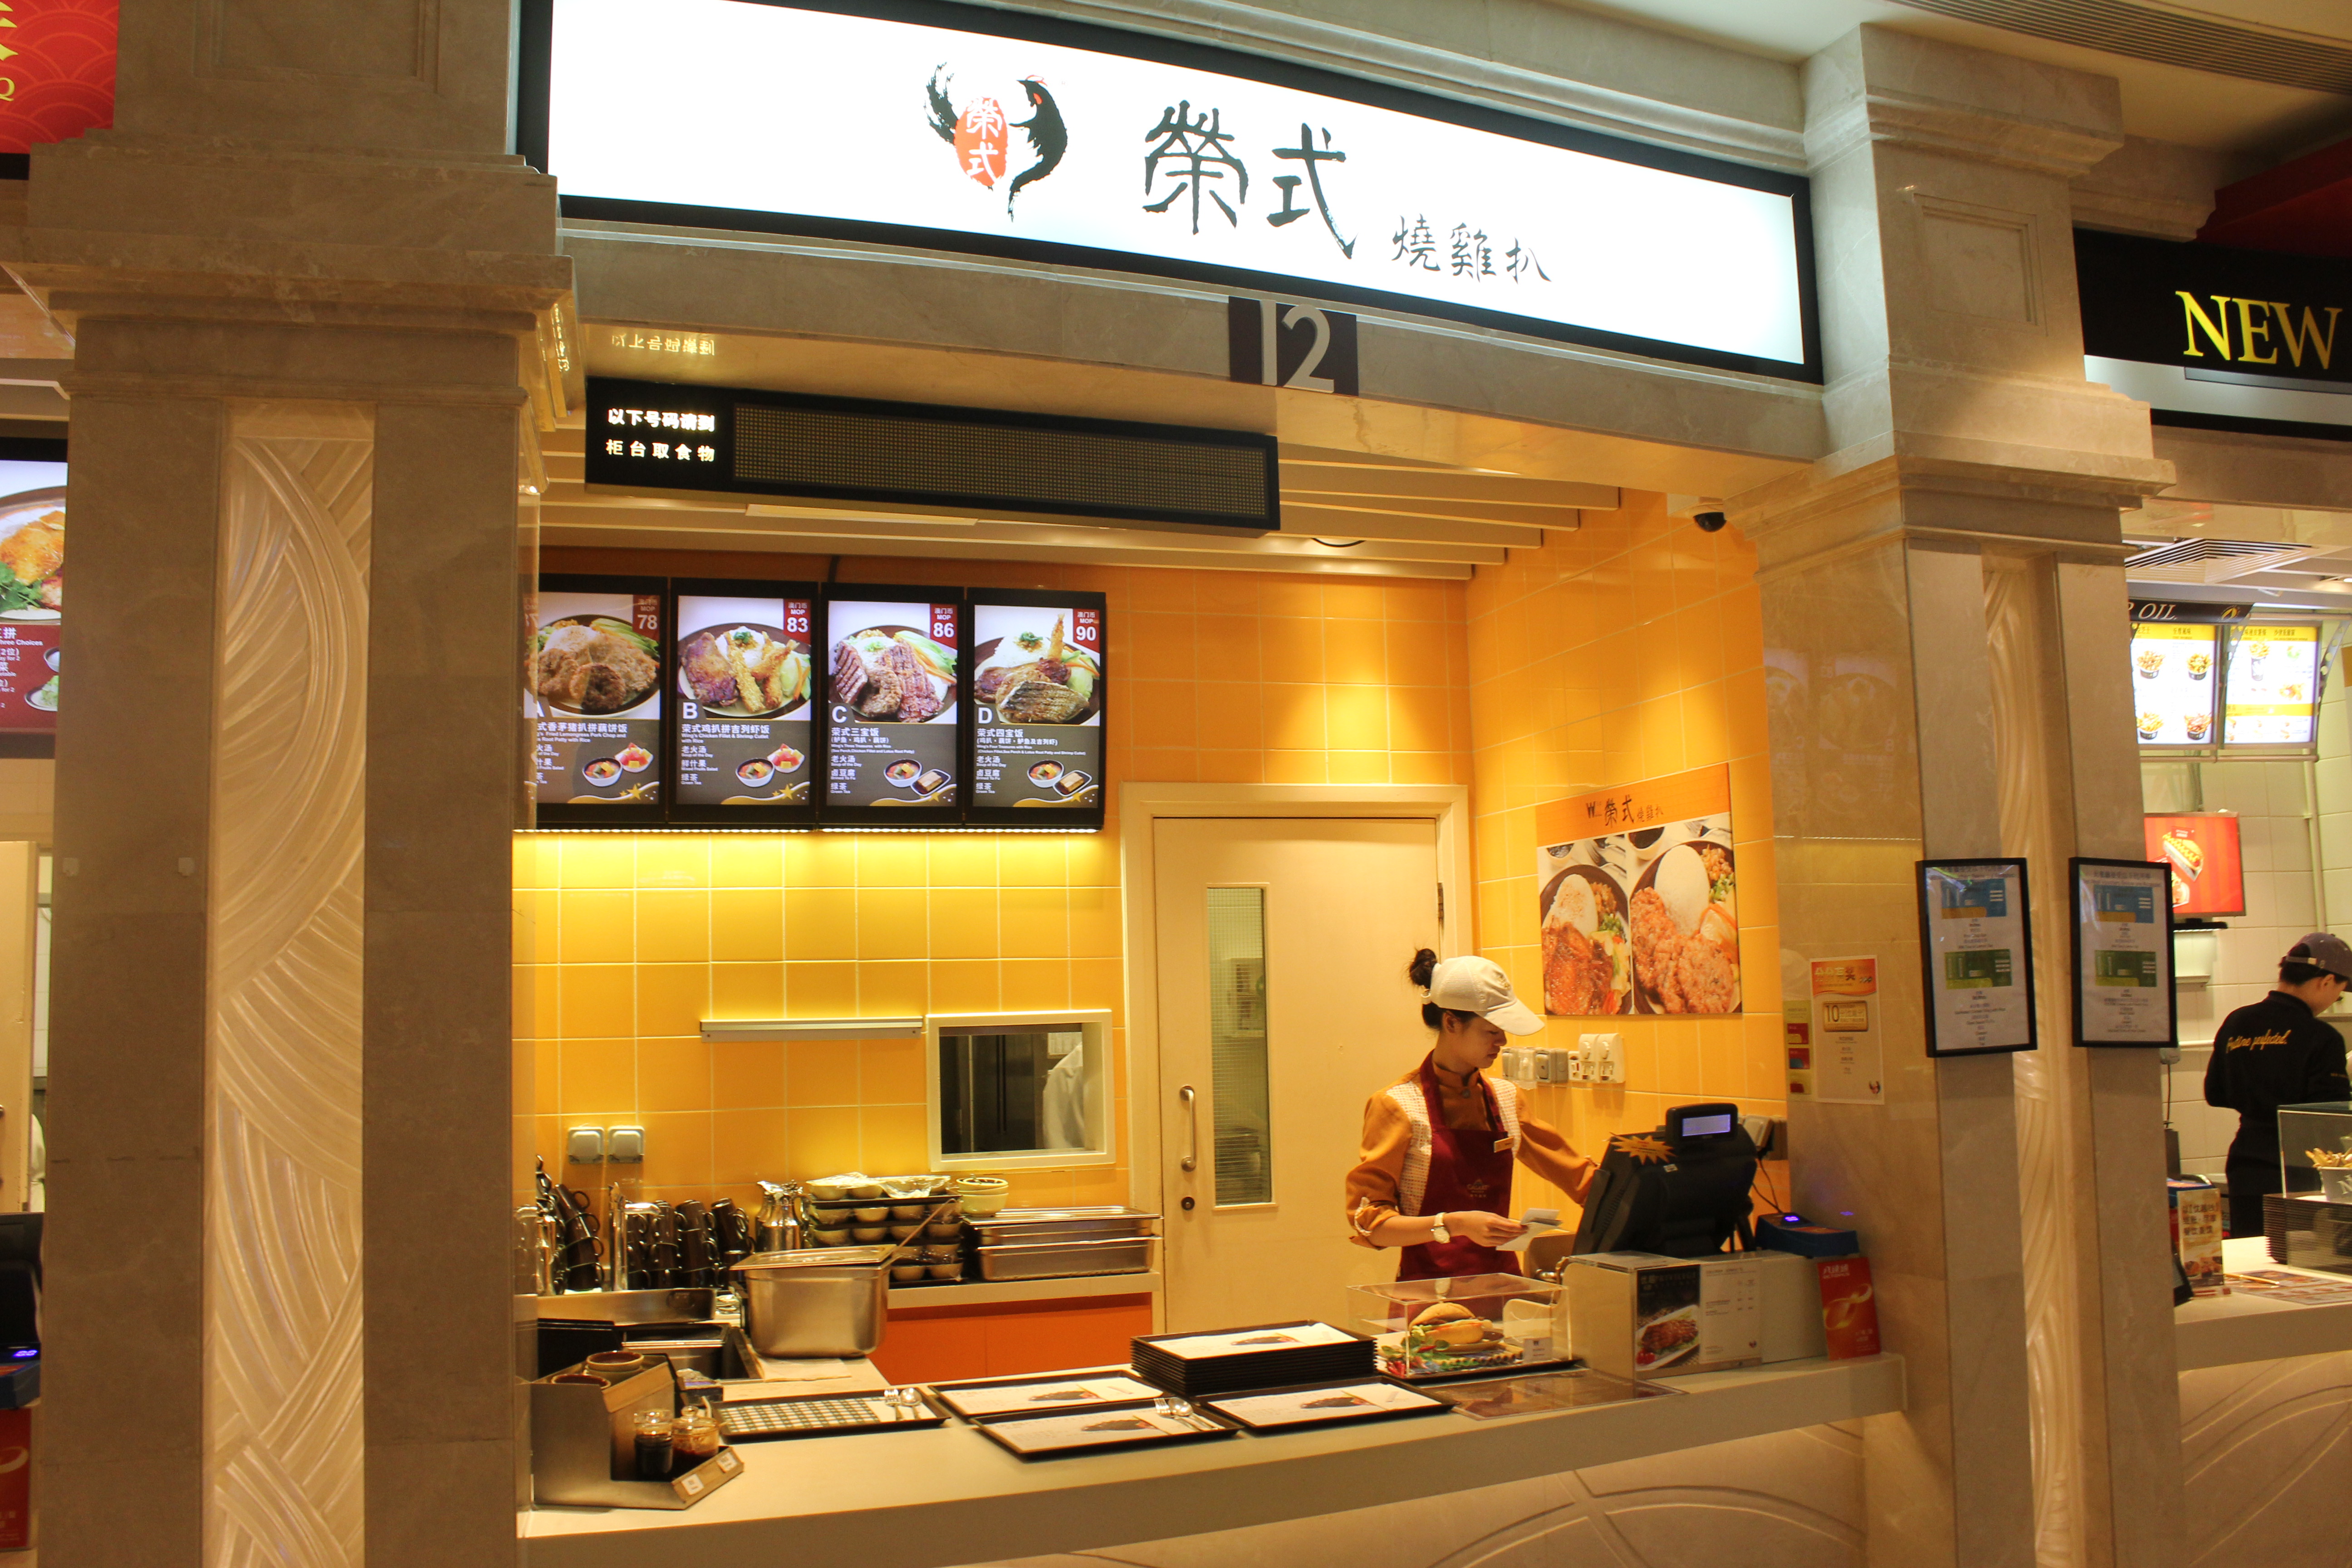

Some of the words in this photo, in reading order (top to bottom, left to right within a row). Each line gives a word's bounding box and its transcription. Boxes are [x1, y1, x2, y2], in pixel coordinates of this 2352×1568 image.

[966, 97, 1003, 183] 榮式
[1143, 100, 1359, 259] 榮式
[1392, 214, 1552, 283] 燒雞扒
[2176, 291, 2343, 370] NEW
[1260, 299, 1334, 394] 12
[608, 408, 715, 432] 以下号码请到
[606, 439, 715, 462] 柜台取食物
[637, 614, 657, 630] 78
[787, 617, 808, 632] 83
[933, 622, 955, 638] 86
[1076, 626, 1097, 642] 90
[682, 702, 698, 719] B
[832, 706, 847, 724] C
[978, 707, 993, 724] D
[681, 724, 770, 734] 荣式鸡扒拼吉列虾饭
[831, 727, 880, 737] 荣式三宝饭
[977, 728, 1024, 738] 荣式四宝饭
[681, 745, 707, 754] 老火汤
[831, 755, 856, 763] 老火汤
[976, 755, 1001, 764] 老火汤
[976, 782, 992, 790] 绿茶
